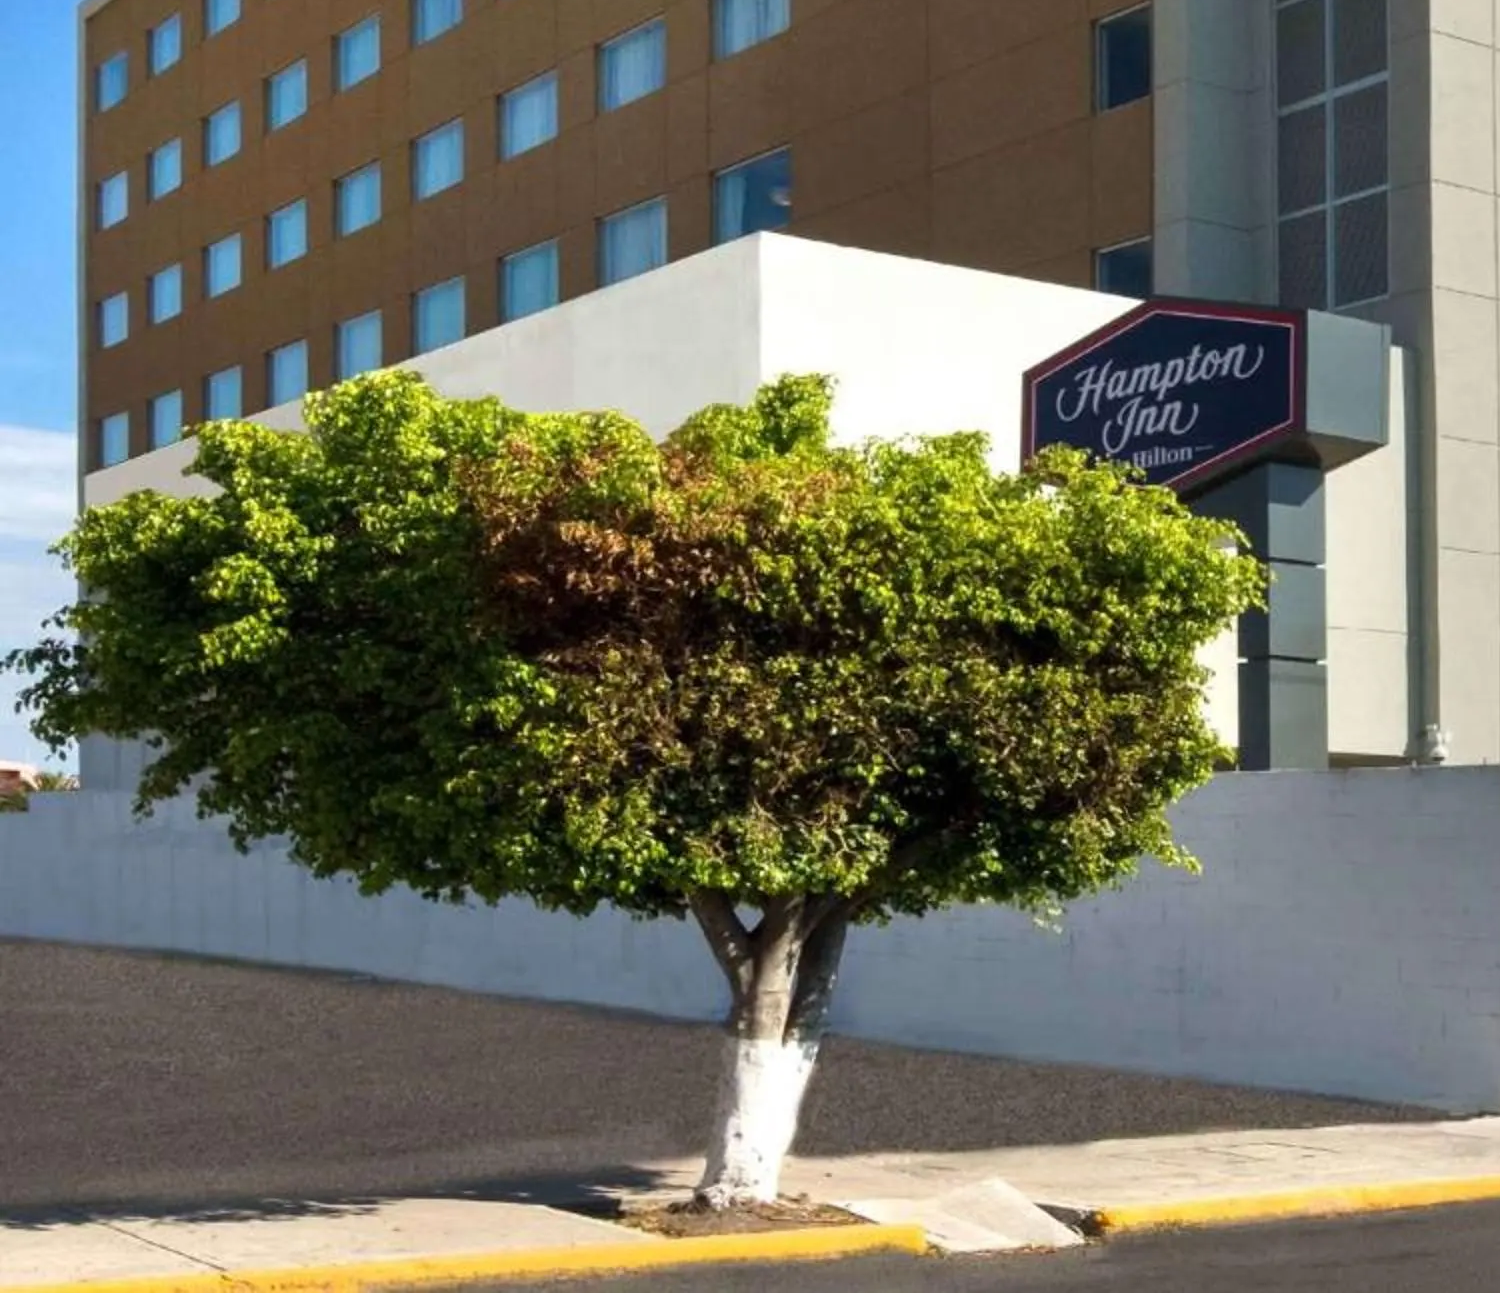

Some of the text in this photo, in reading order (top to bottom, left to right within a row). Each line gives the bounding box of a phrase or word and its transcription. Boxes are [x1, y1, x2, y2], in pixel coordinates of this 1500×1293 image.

[1056, 342, 1264, 422] Hampton
[1102, 397, 1199, 454] Inn
[1132, 445, 1193, 469] Hilton
